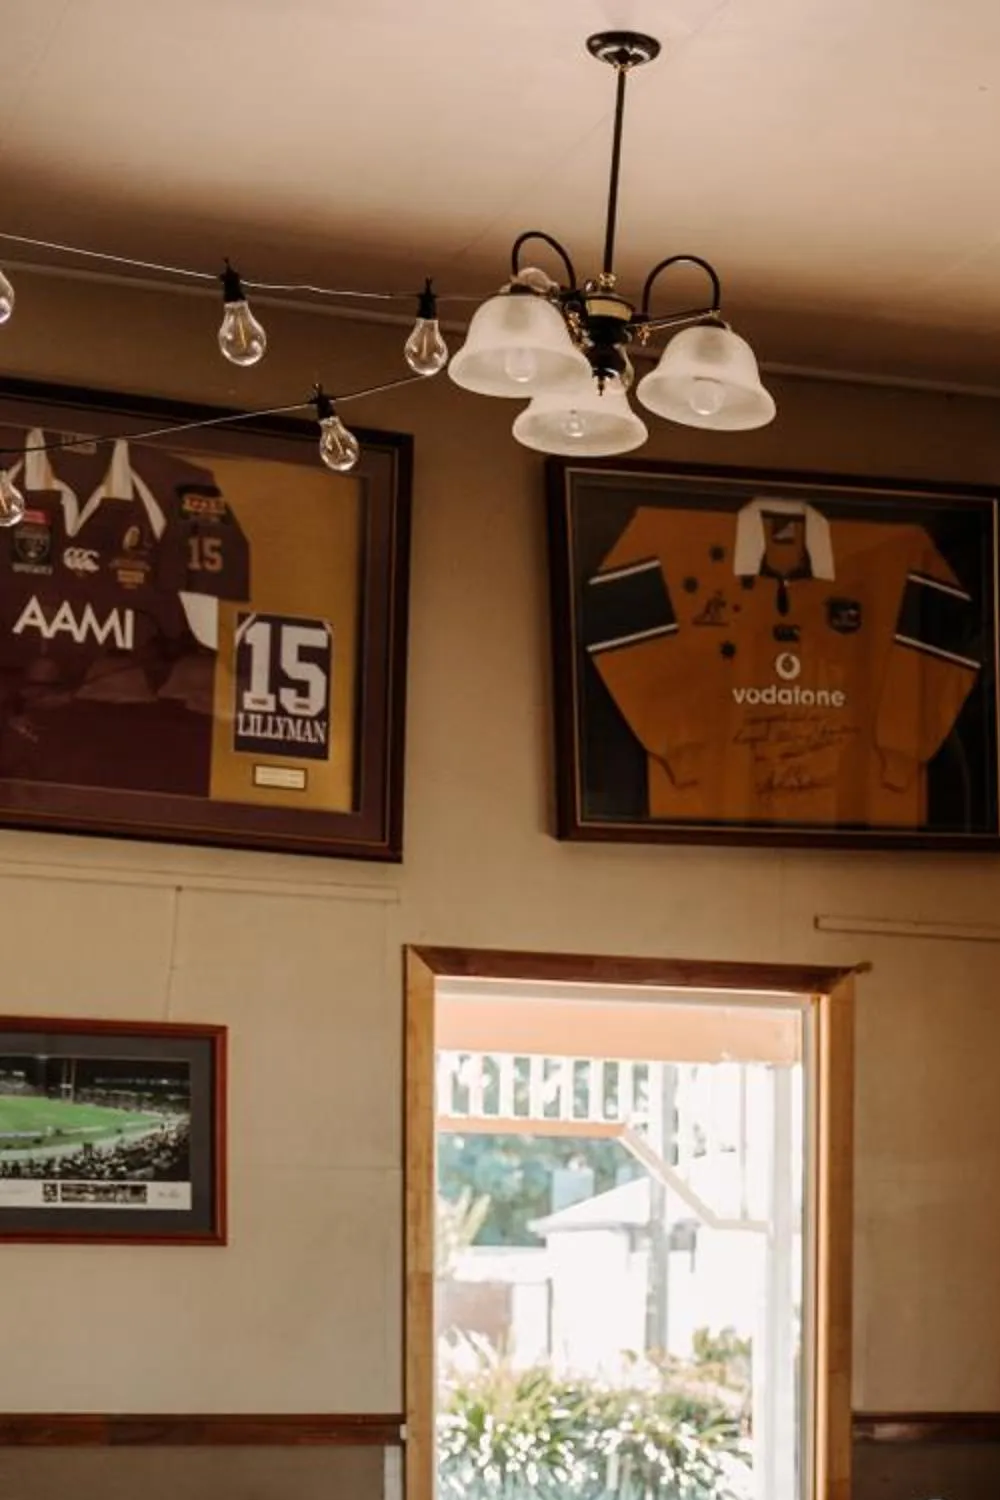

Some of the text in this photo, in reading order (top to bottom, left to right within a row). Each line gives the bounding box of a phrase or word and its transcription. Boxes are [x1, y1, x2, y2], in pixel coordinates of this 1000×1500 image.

[188, 537, 223, 571] 15
[12, 594, 134, 650] AAMI
[243, 621, 329, 717] 15
[732, 684, 846, 707] vodafone
[237, 712, 327, 744] LILLYMAN
